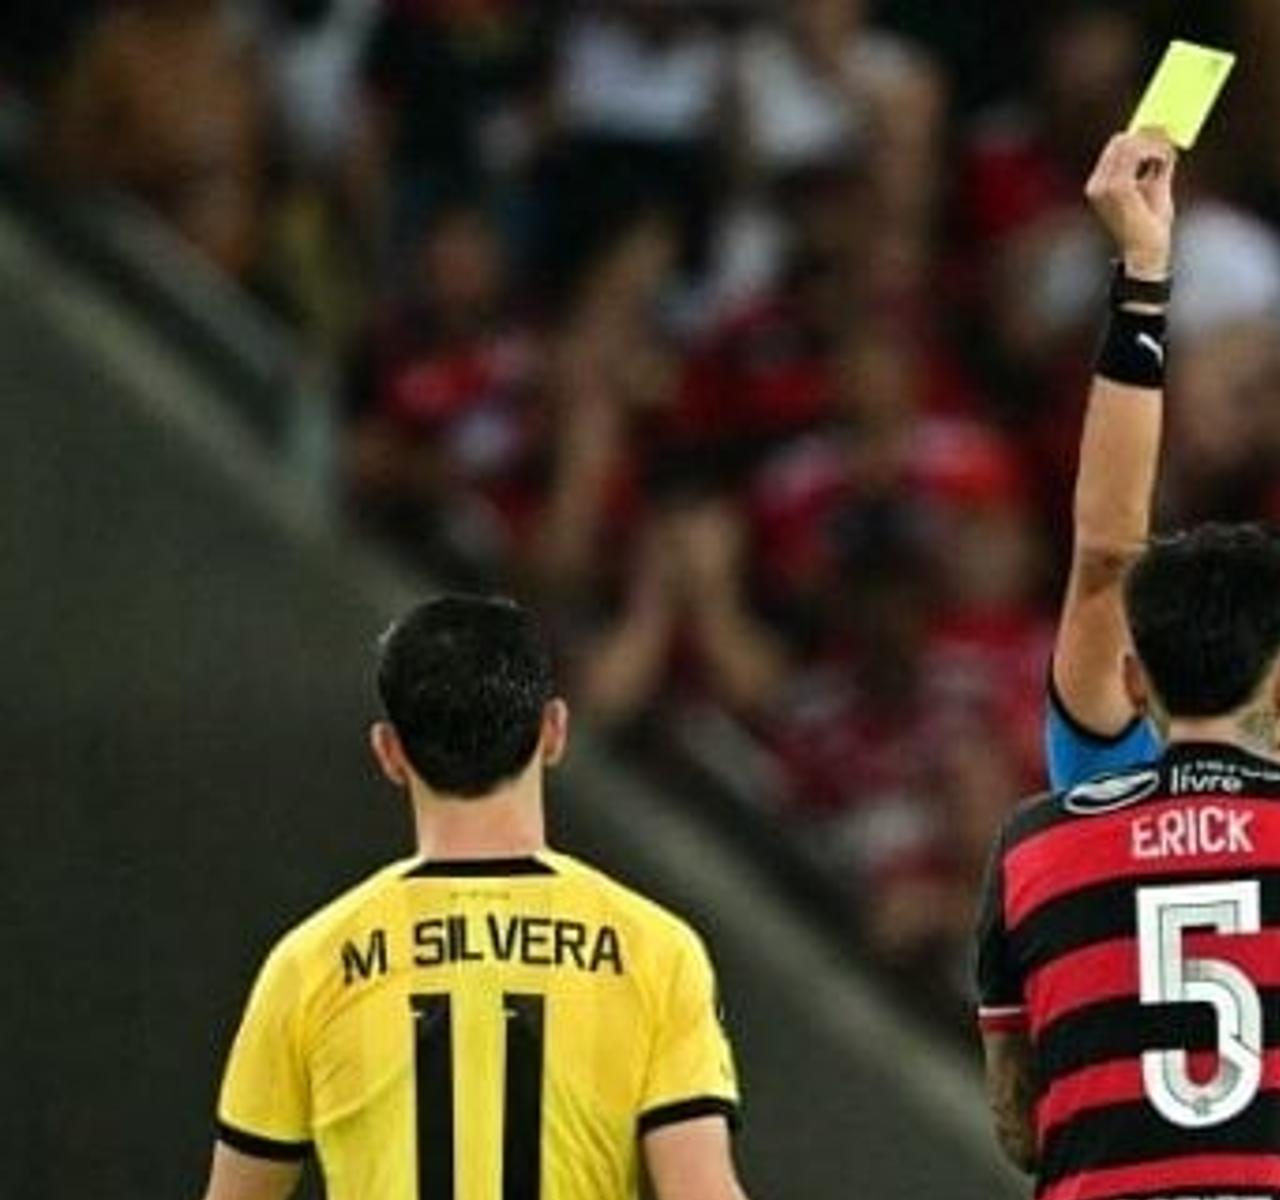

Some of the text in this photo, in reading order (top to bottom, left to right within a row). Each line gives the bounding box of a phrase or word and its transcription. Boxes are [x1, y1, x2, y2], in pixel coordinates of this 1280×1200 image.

[1169, 765, 1243, 794] livre
[1130, 805, 1255, 859] ERICK
[340, 913, 623, 984] M SILVERA
[1136, 880, 1263, 1128] 5
